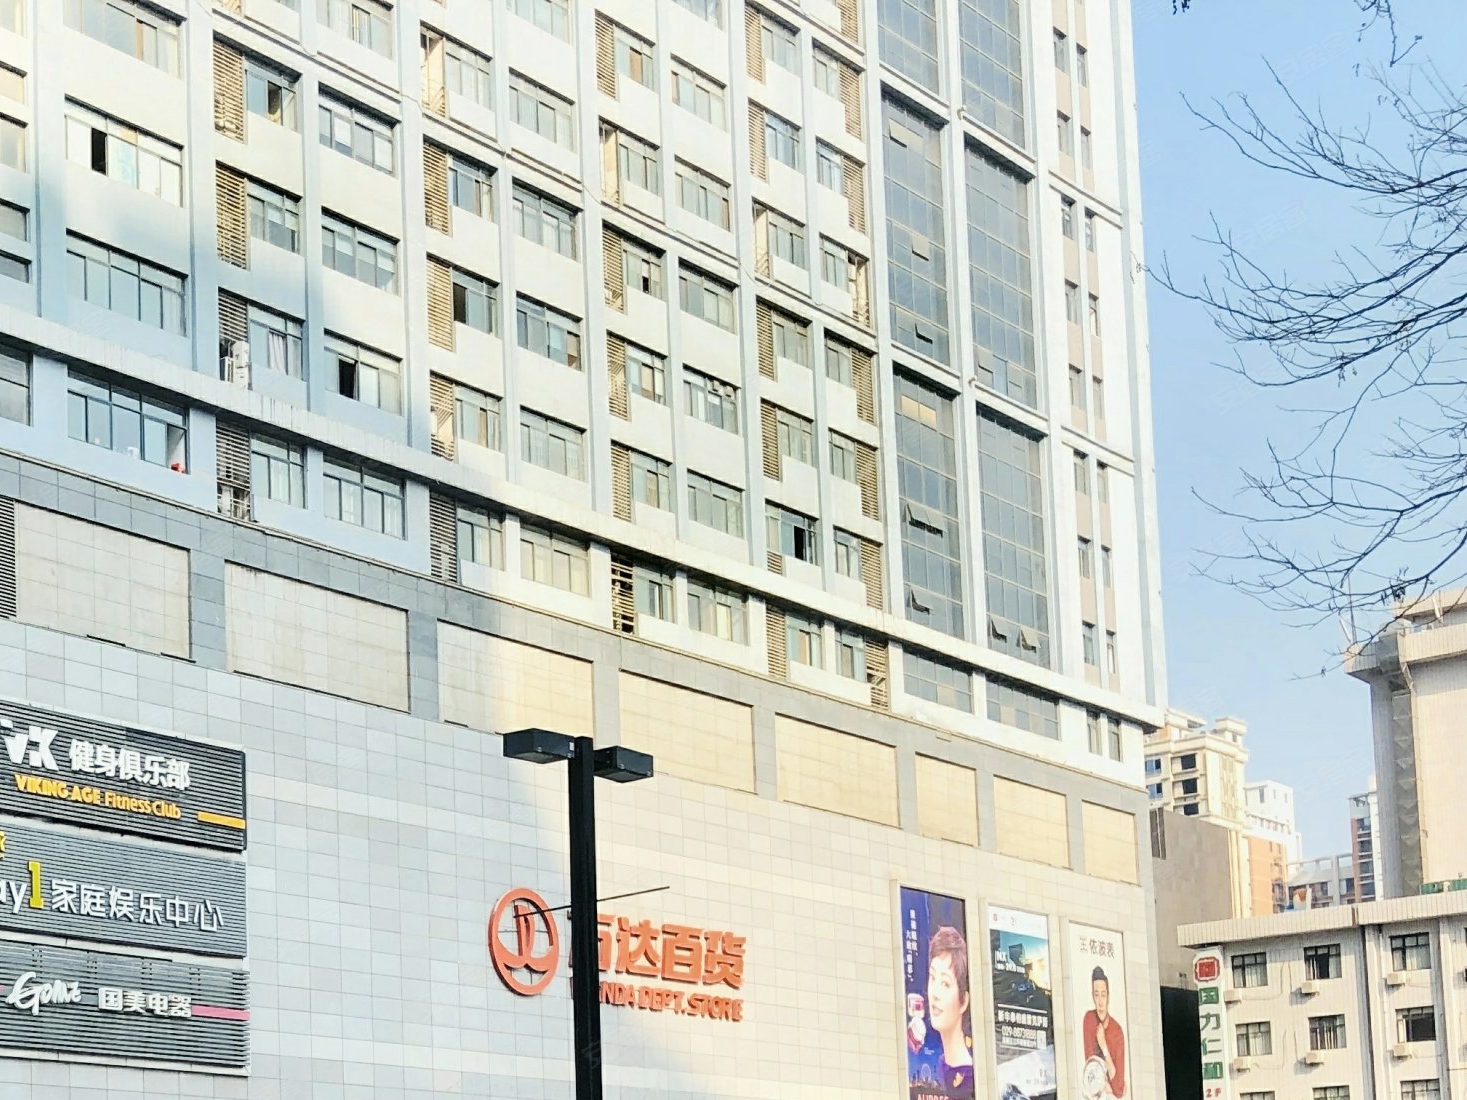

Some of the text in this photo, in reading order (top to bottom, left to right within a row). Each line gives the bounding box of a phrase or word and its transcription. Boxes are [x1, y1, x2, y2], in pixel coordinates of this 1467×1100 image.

[69, 738, 191, 791] 健身俱乐部
[15, 775, 182, 820] VIKING AGE Fitness Club
[50, 879, 224, 932] 家庭娱乐中心
[98, 987, 192, 1018] 国美电器
[1199, 987, 1223, 1079] 国力仁和
